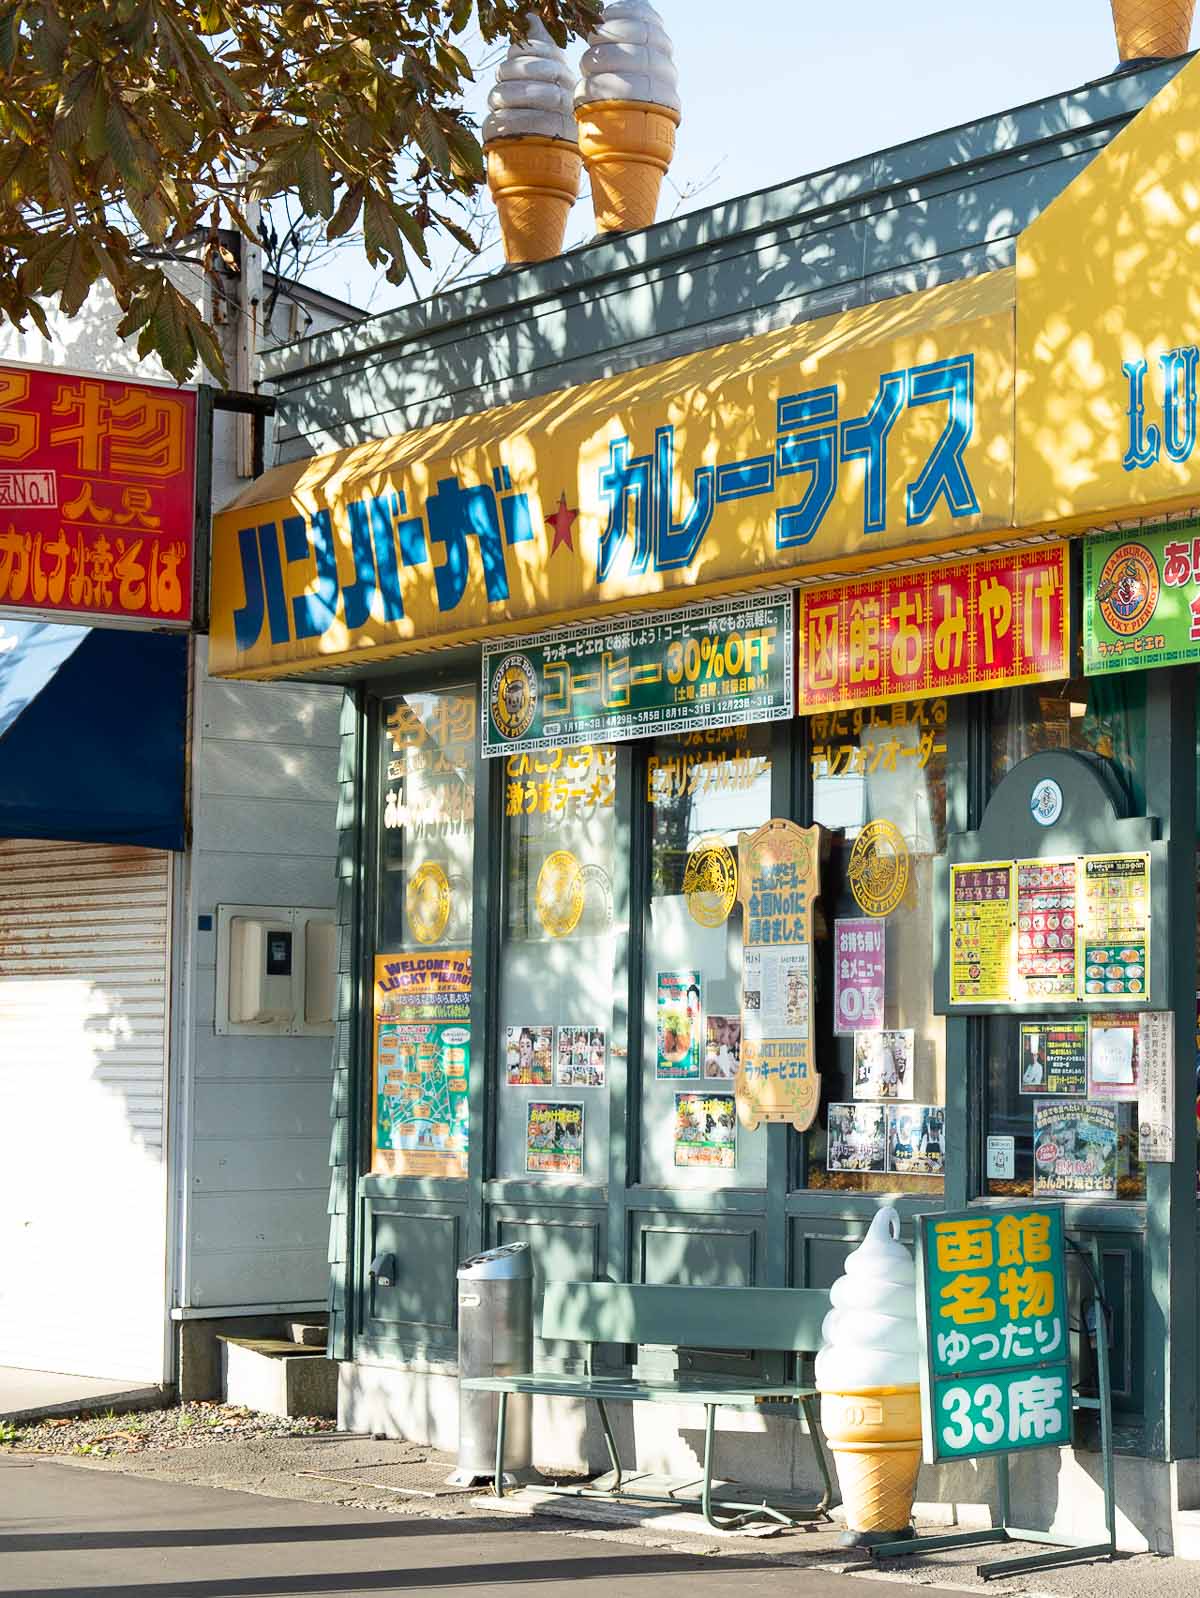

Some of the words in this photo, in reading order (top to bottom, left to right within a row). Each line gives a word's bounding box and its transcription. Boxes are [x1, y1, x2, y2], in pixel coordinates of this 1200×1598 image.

[600, 353, 981, 584] カレーライス
[62, 482, 160, 528] 人見
[234, 462, 535, 652] ハンバーガー
[1105, 547, 1154, 575] HAMBURGER
[808, 566, 1060, 690] 函館おみやげ
[1103, 604, 1128, 632] LUCKY
[1131, 585, 1157, 632] PIERROT
[667, 626, 777, 685] 30%OFF
[1098, 635, 1165, 657] ラッキーピエロ
[543, 651, 662, 717] コーヒー
[810, 731, 948, 780] テレフォンオーダー
[749, 918, 804, 944] 輝きました
[840, 931, 881, 953] お持ち帰り
[378, 974, 427, 993] LUCKY
[384, 959, 450, 976] WELCOME
[453, 961, 463, 972] TO
[840, 959, 882, 980] 全メニュー
[840, 986, 881, 1021] OK
[744, 1060, 807, 1081] ラッキーピエロ
[935, 1213, 1051, 1272] 函館
[940, 1266, 1055, 1325] 名物
[937, 1318, 1062, 1365] ゆったり
[942, 1376, 1063, 1449] 33席
